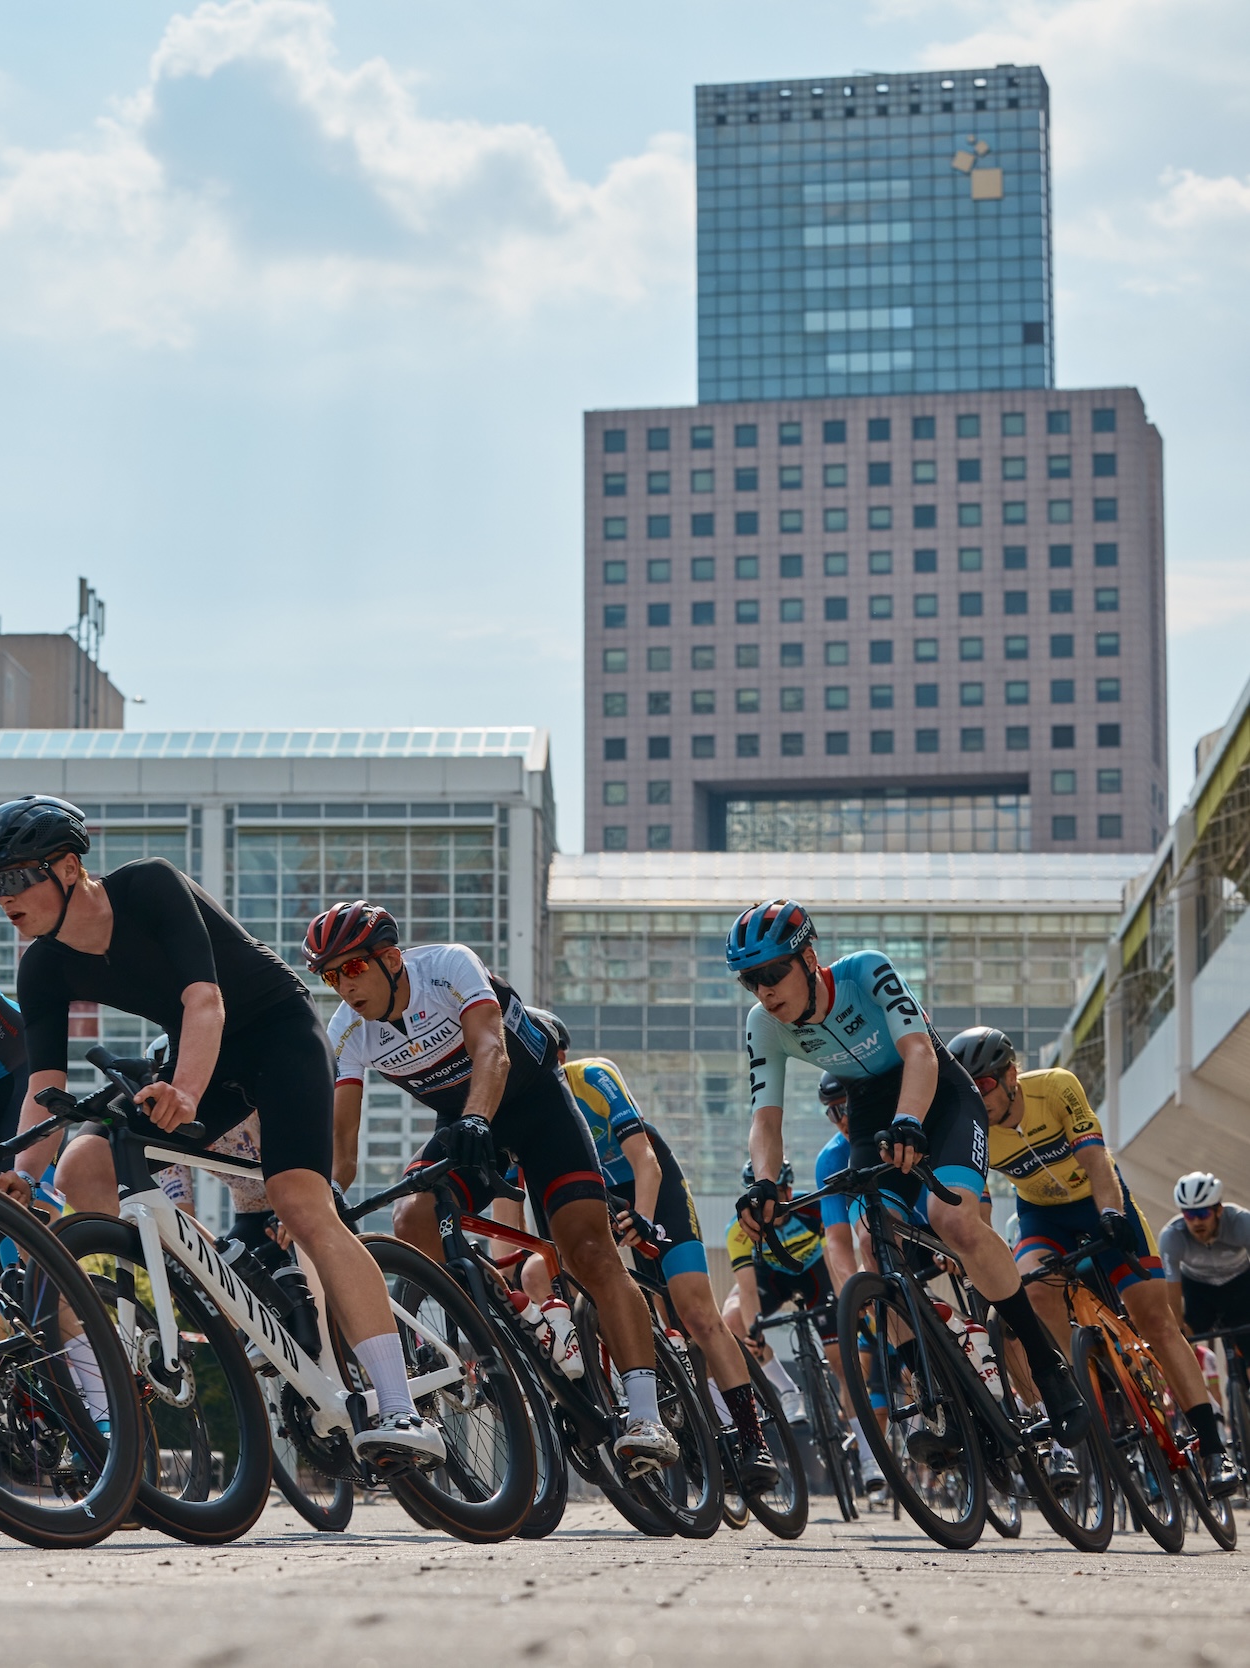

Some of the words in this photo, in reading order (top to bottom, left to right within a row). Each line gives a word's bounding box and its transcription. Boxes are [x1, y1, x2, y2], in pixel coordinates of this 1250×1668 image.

[380, 1026, 453, 1068] EHRMANN
[972, 1119, 985, 1171] GGEW
[1023, 1141, 1070, 1171] Frankfurt
[175, 1208, 300, 1373] CANYON
[192, 1289, 221, 1318] DT
